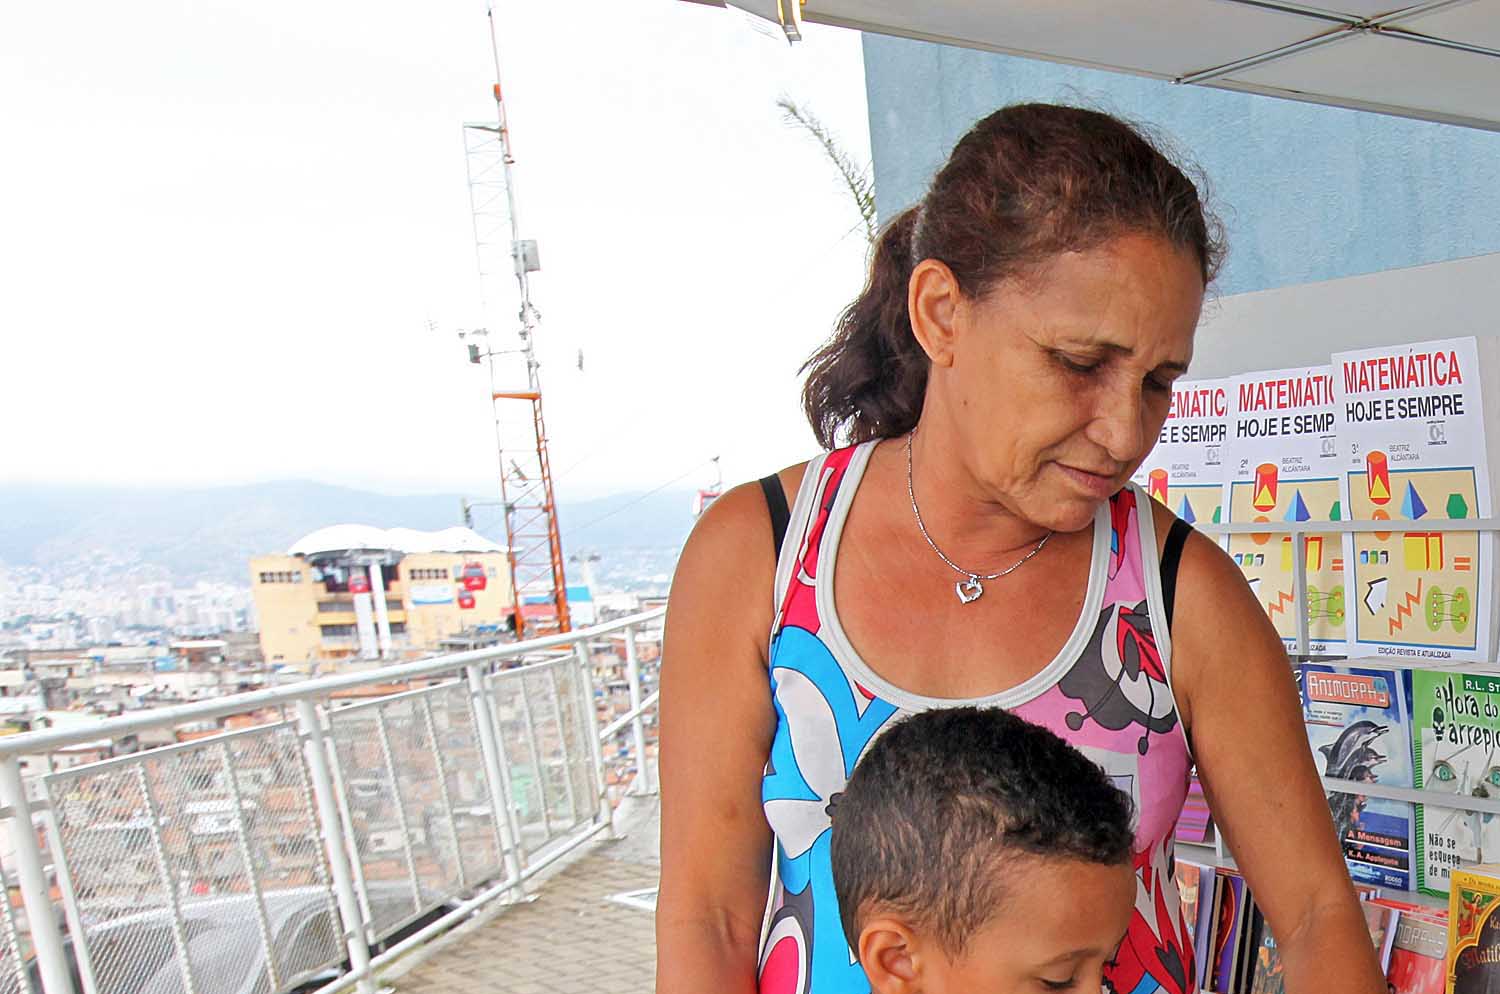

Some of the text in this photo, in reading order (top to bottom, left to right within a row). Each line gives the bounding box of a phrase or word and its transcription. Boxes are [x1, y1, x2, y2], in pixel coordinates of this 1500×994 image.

[1343, 349, 1462, 393] MATEMÁTICA
[1435, 676, 1498, 719] a Hora do
[1465, 681, 1484, 691] R.L.
